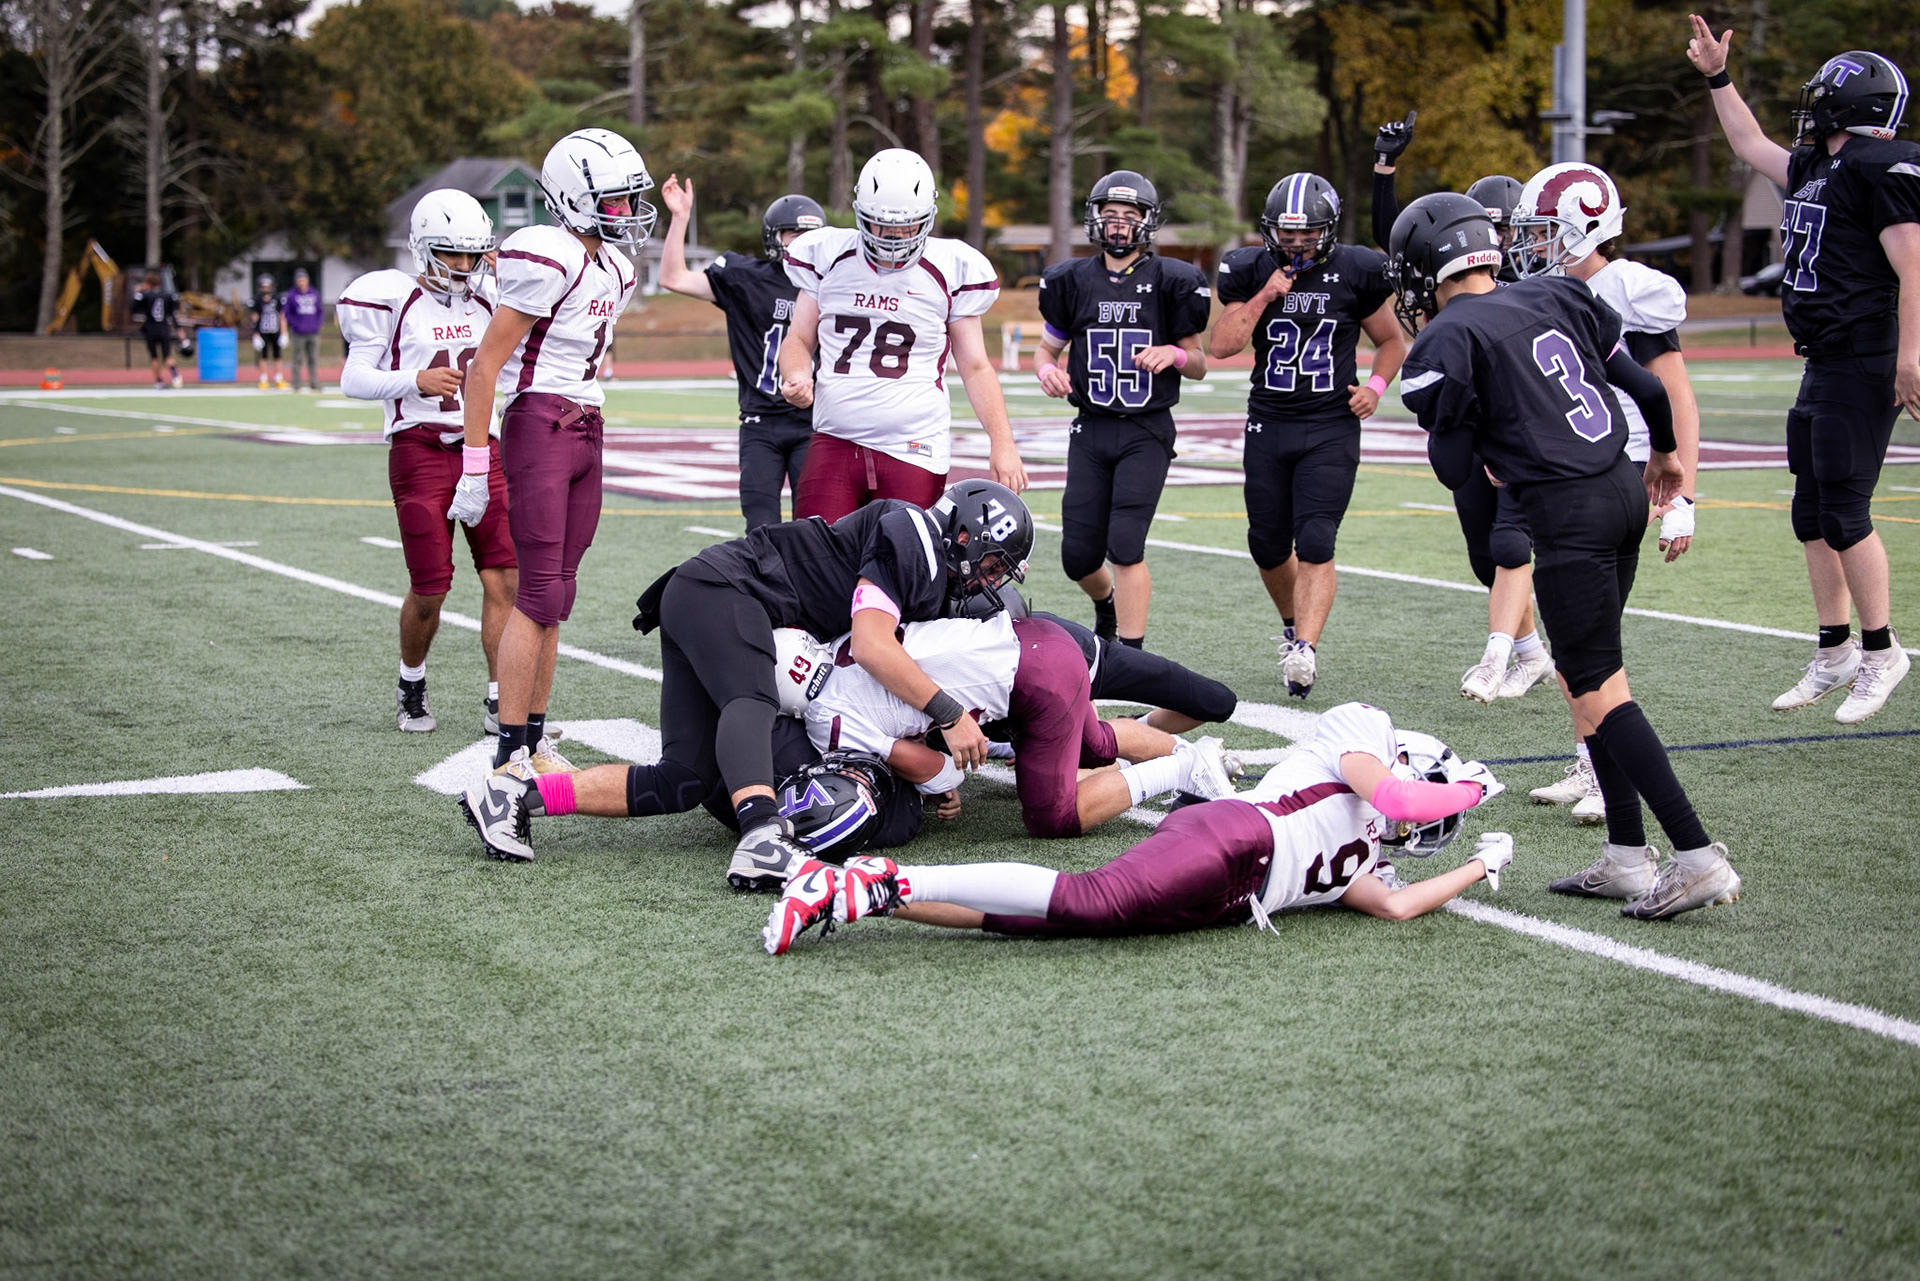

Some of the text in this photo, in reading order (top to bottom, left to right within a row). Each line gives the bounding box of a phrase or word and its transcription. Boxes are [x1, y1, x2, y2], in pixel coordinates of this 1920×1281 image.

[1467, 253, 1500, 266] Riddel
[1780, 200, 1827, 292] 77
[588, 300, 614, 317] RAM
[853, 293, 899, 312] RAMS
[1099, 301, 1141, 323] BVT
[1283, 292, 1330, 314] BVT
[432, 325, 472, 341] RAMS
[582, 321, 607, 381] 1
[833, 314, 917, 379] 78
[1086, 328, 1153, 408] 55
[1264, 318, 1338, 392] 24
[1532, 328, 1612, 443] 3
[975, 498, 1018, 541] 78
[788, 655, 812, 685] 49
[808, 665, 828, 698] schutt
[1303, 837, 1370, 896] 9
